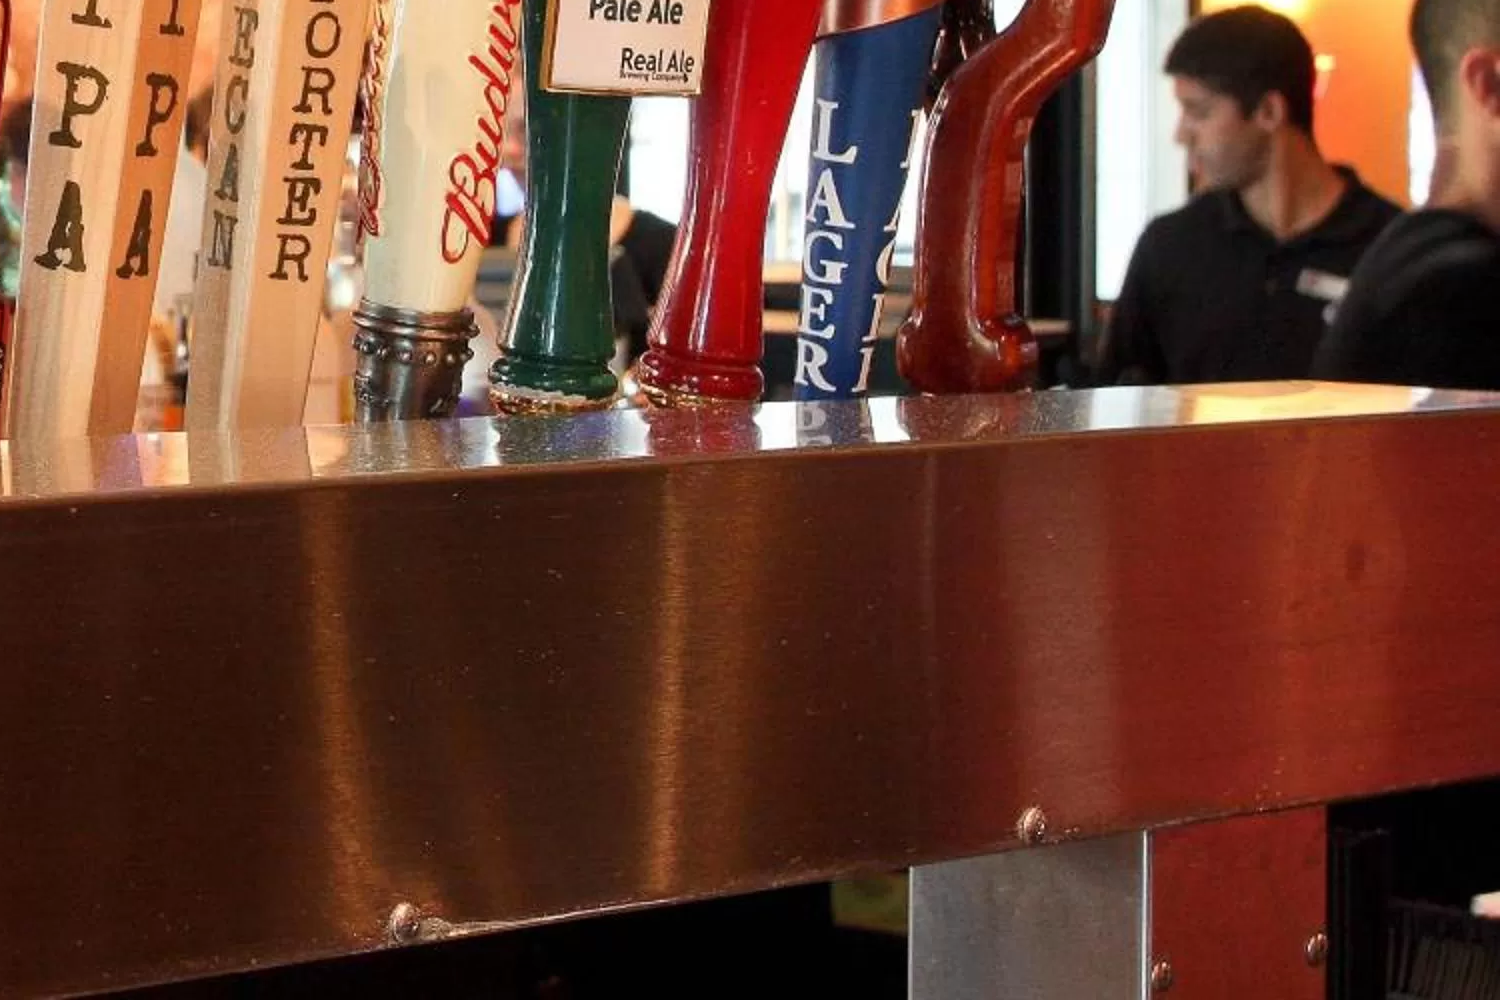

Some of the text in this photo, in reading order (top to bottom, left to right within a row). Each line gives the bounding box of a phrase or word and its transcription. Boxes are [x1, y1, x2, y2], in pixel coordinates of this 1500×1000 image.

[621, 47, 695, 73] Real Ale
[794, 97, 858, 395] LAGER
